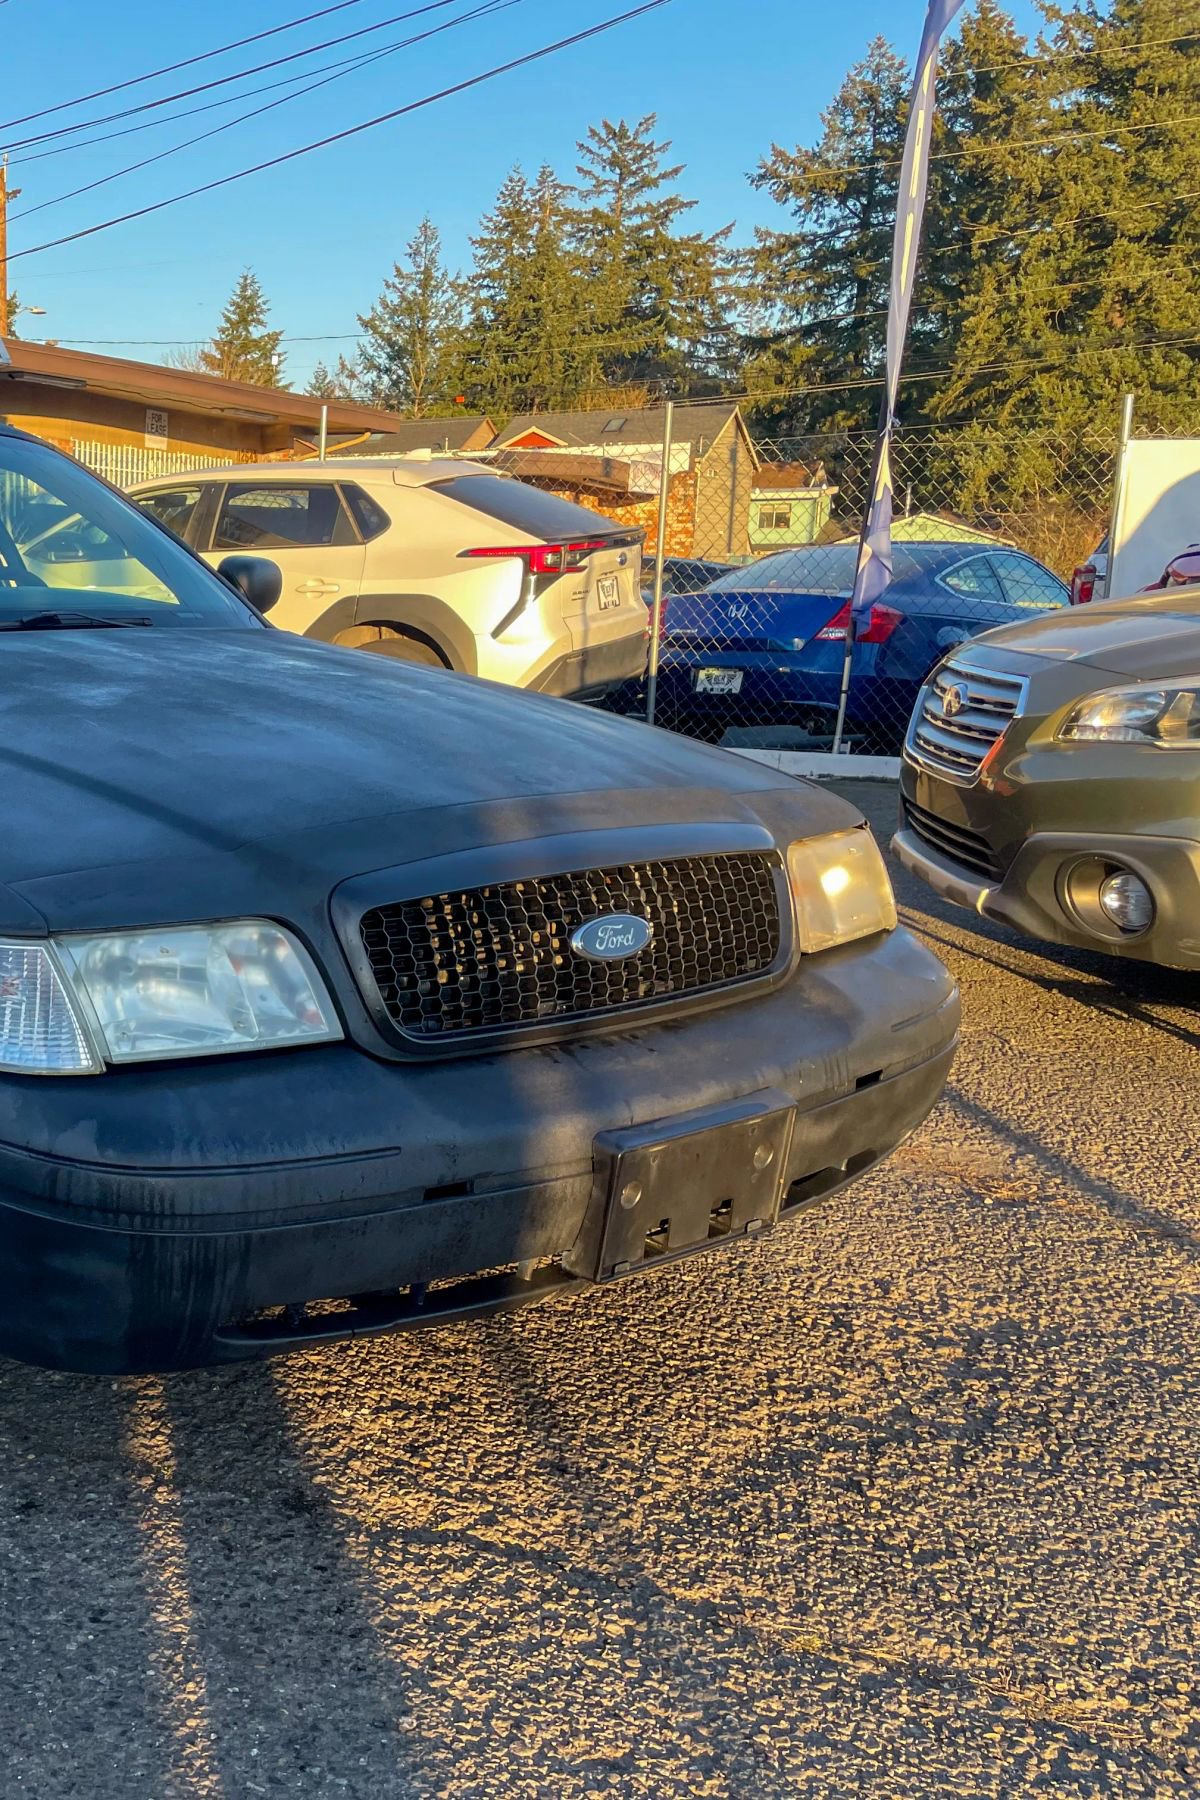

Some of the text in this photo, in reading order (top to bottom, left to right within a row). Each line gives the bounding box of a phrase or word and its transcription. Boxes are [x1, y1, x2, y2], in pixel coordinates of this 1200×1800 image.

[151, 412, 163, 424] FOR
[146, 423, 167, 434] LEASE
[595, 924, 635, 951] Ford
